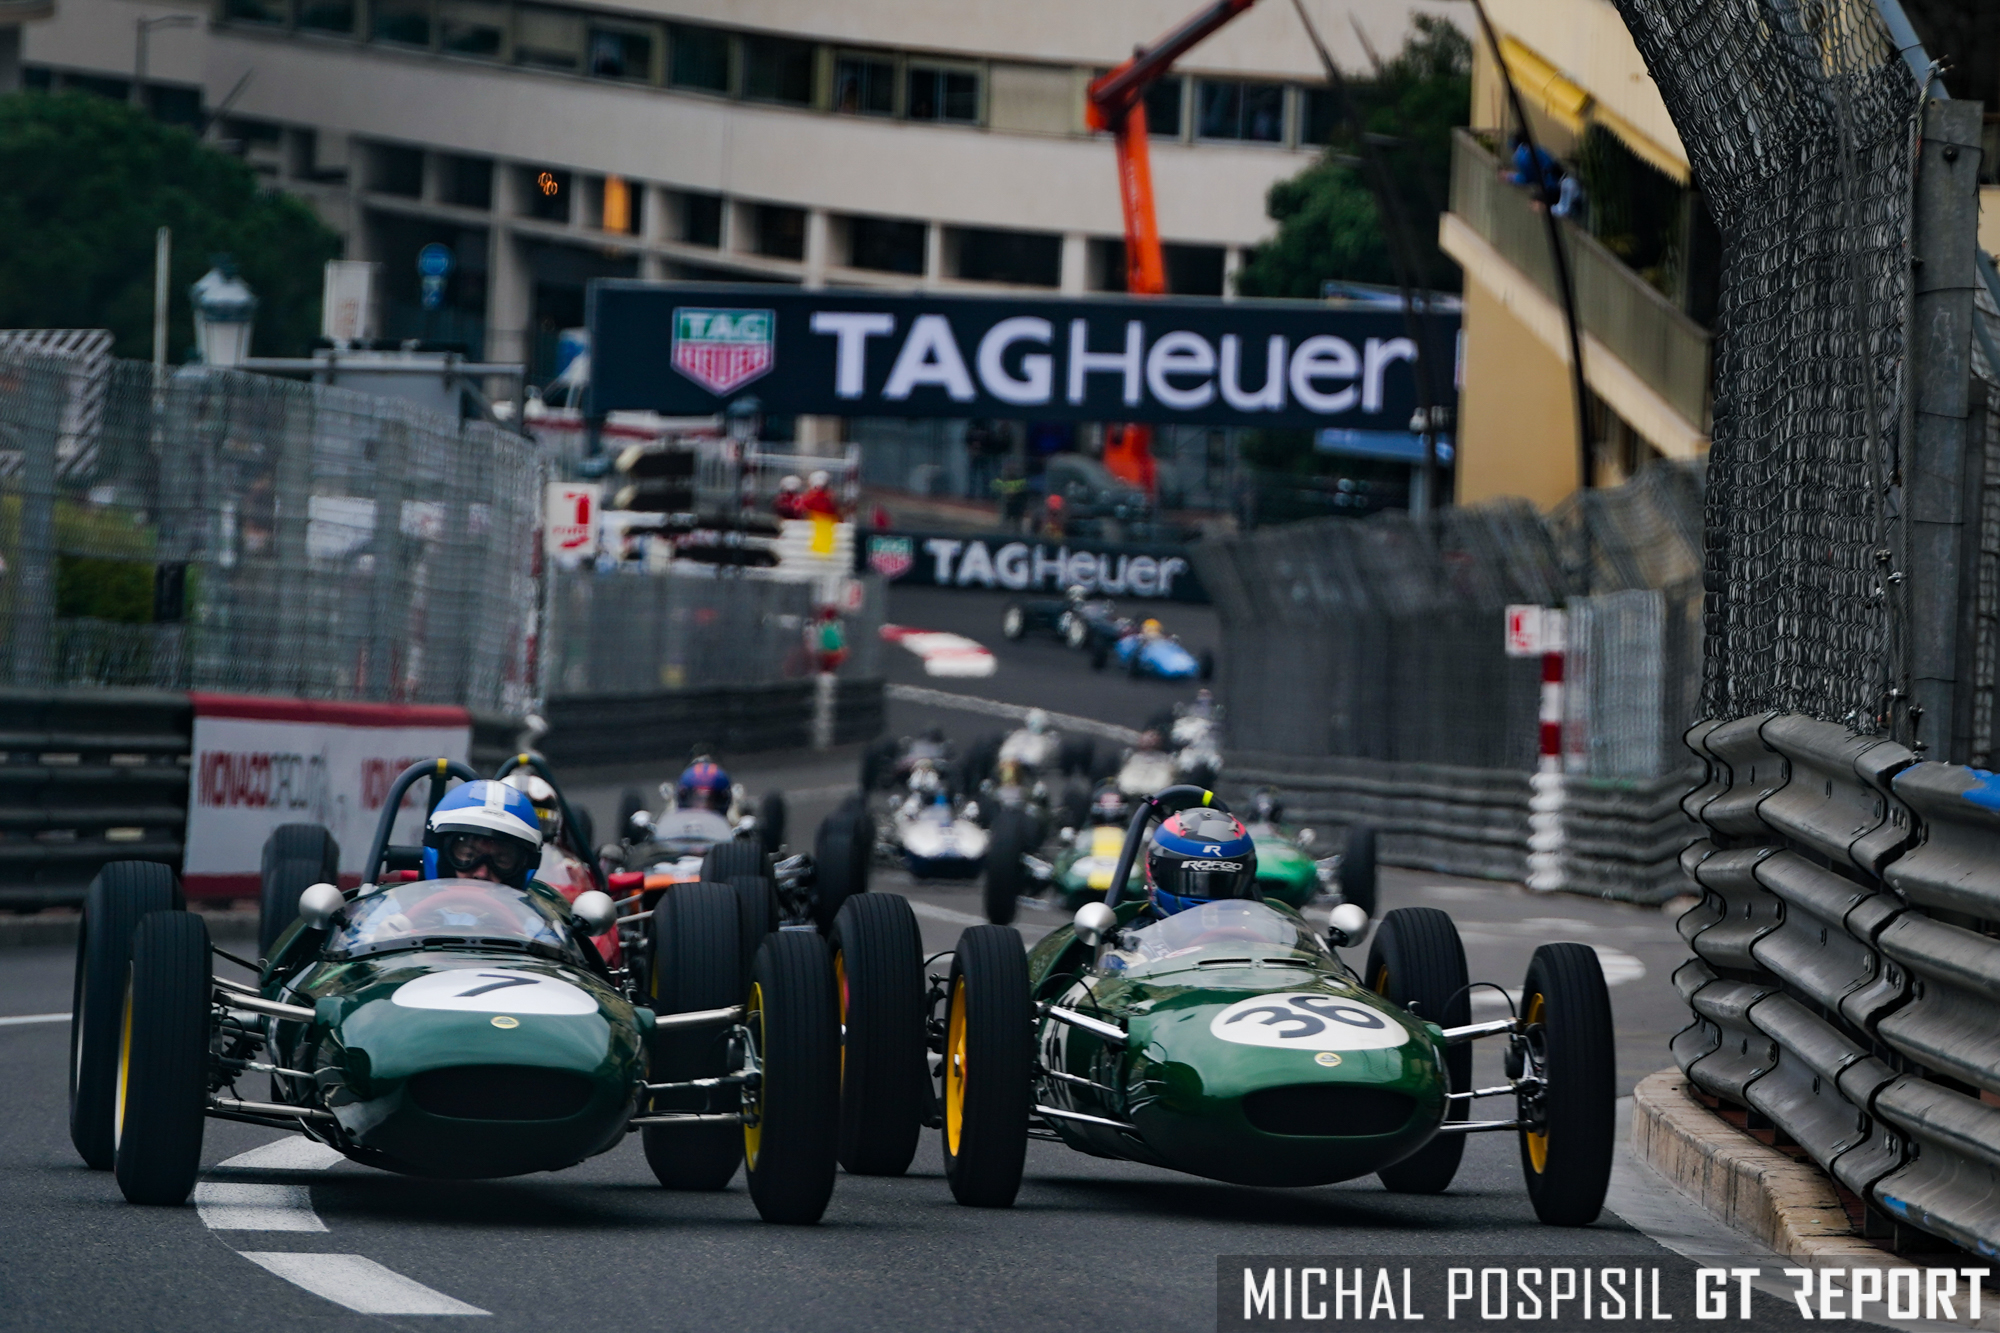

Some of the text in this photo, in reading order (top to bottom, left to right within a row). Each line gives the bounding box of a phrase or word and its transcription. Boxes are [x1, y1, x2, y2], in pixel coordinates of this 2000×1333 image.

[681, 313, 767, 337] TAG
[1202, 845, 1222, 857] R
[1180, 860, 1243, 871] ROFGO
[453, 973, 542, 997] 7
[1224, 995, 1386, 1039] 36
